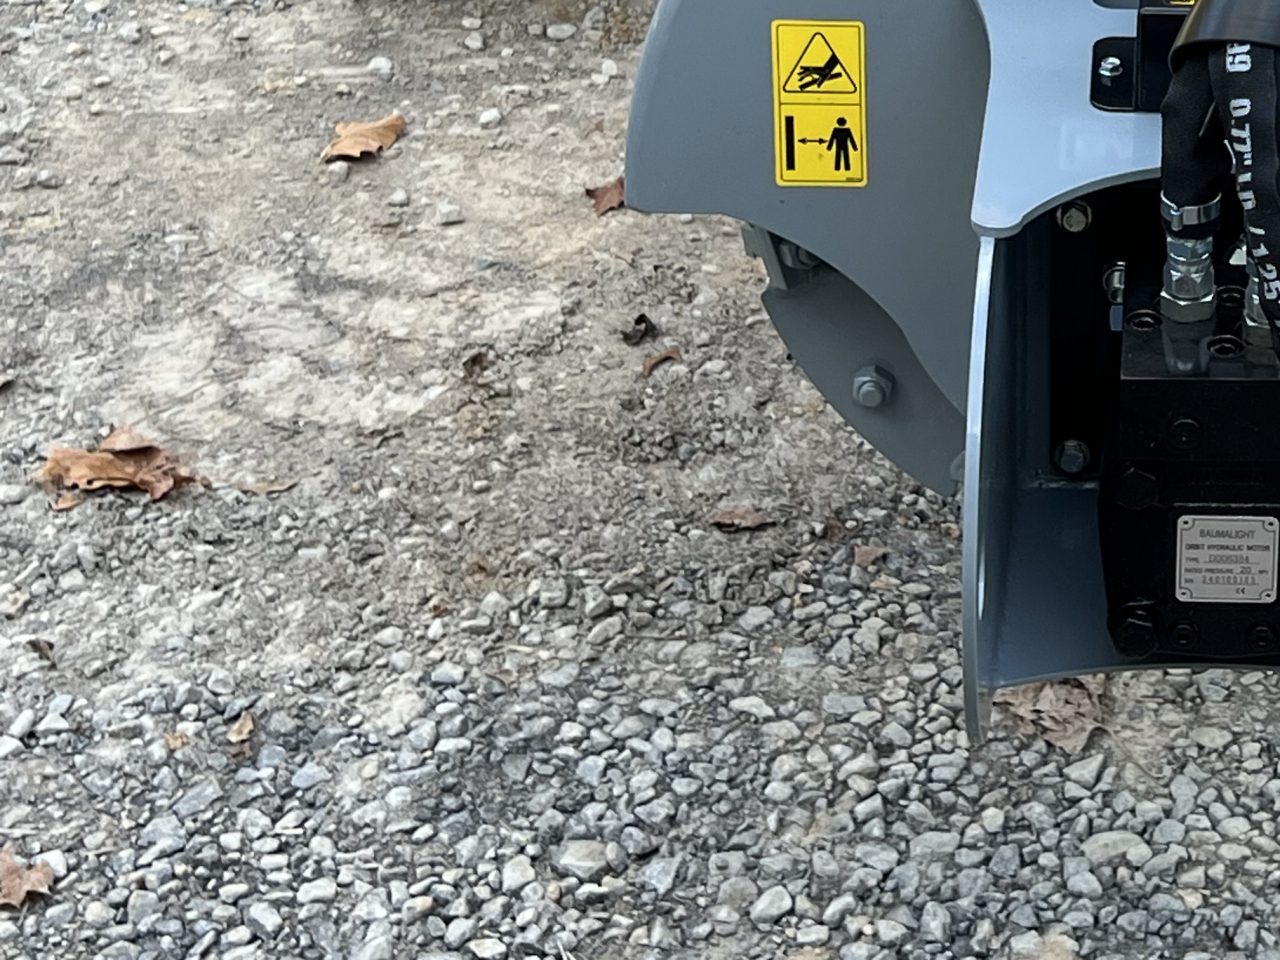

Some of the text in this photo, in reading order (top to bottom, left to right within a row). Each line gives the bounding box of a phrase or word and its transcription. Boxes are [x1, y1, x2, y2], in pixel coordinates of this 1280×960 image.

[1199, 529, 1256, 540] BAUMALIGHT
[1184, 543, 1271, 552] ORBIT HYDRAULIC MOTOR
